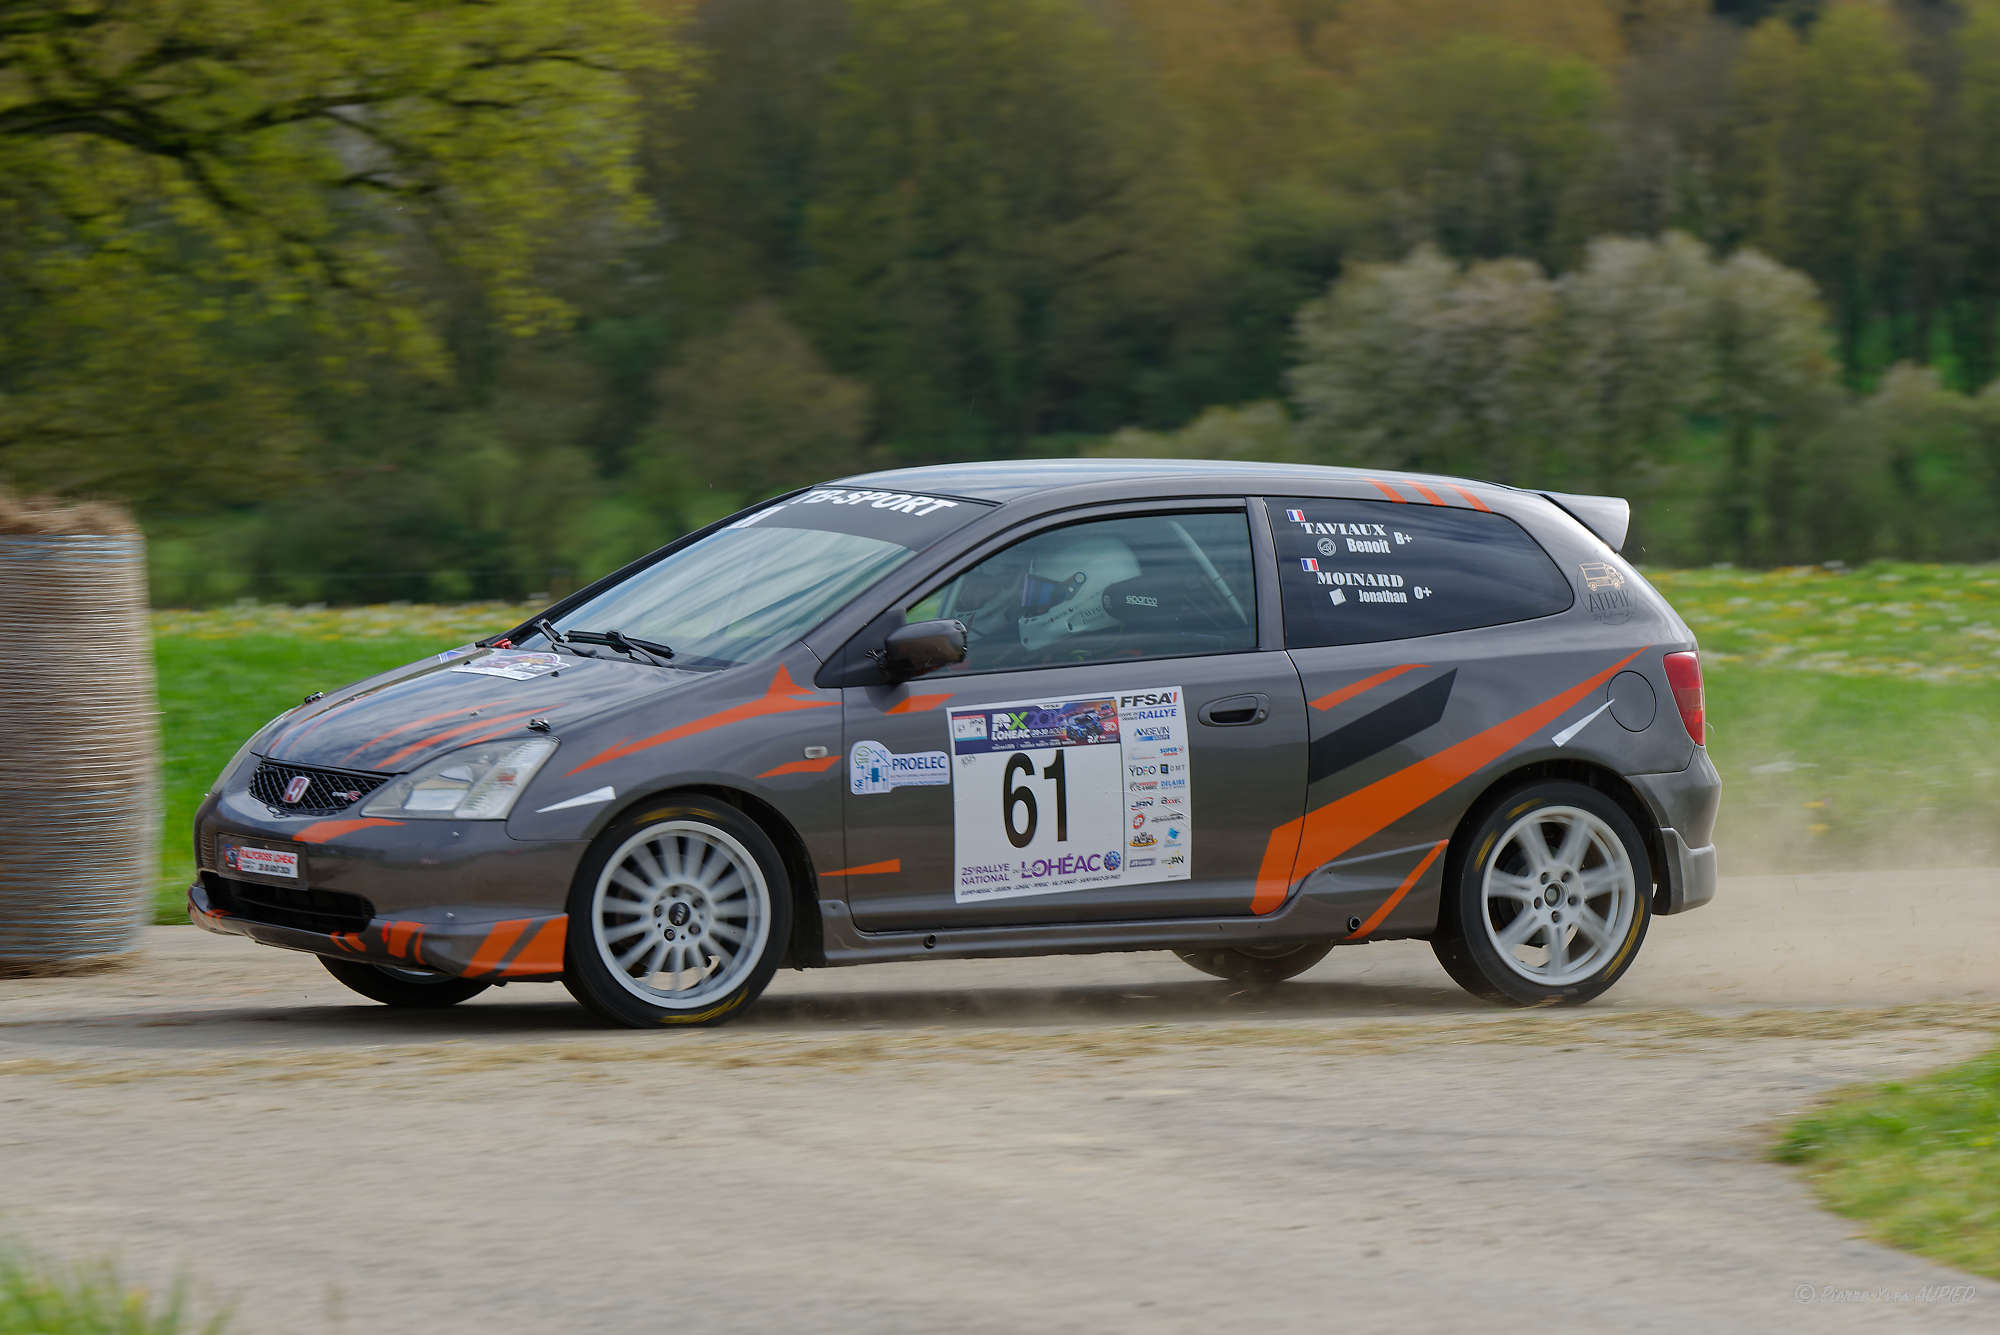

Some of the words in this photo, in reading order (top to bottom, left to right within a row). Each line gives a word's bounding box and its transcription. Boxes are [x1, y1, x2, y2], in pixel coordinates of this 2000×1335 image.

[790, 490, 959, 517] TB-SPORT
[1300, 522, 1387, 536] TAVIAUX
[1393, 532, 1413, 545] B+
[1316, 571, 1404, 587] MOINARD
[1358, 589, 1408, 603] Jonathan
[1120, 692, 1174, 708] FFSA
[992, 711, 1029, 731] RX
[1139, 708, 1177, 720] RALLYE
[892, 756, 946, 770] PROELEC
[1003, 749, 1068, 849] 61
[975, 863, 1010, 874] RALLYE
[1021, 853, 1101, 879] LOHÉAC
[961, 875, 1010, 886] NATIONAL
